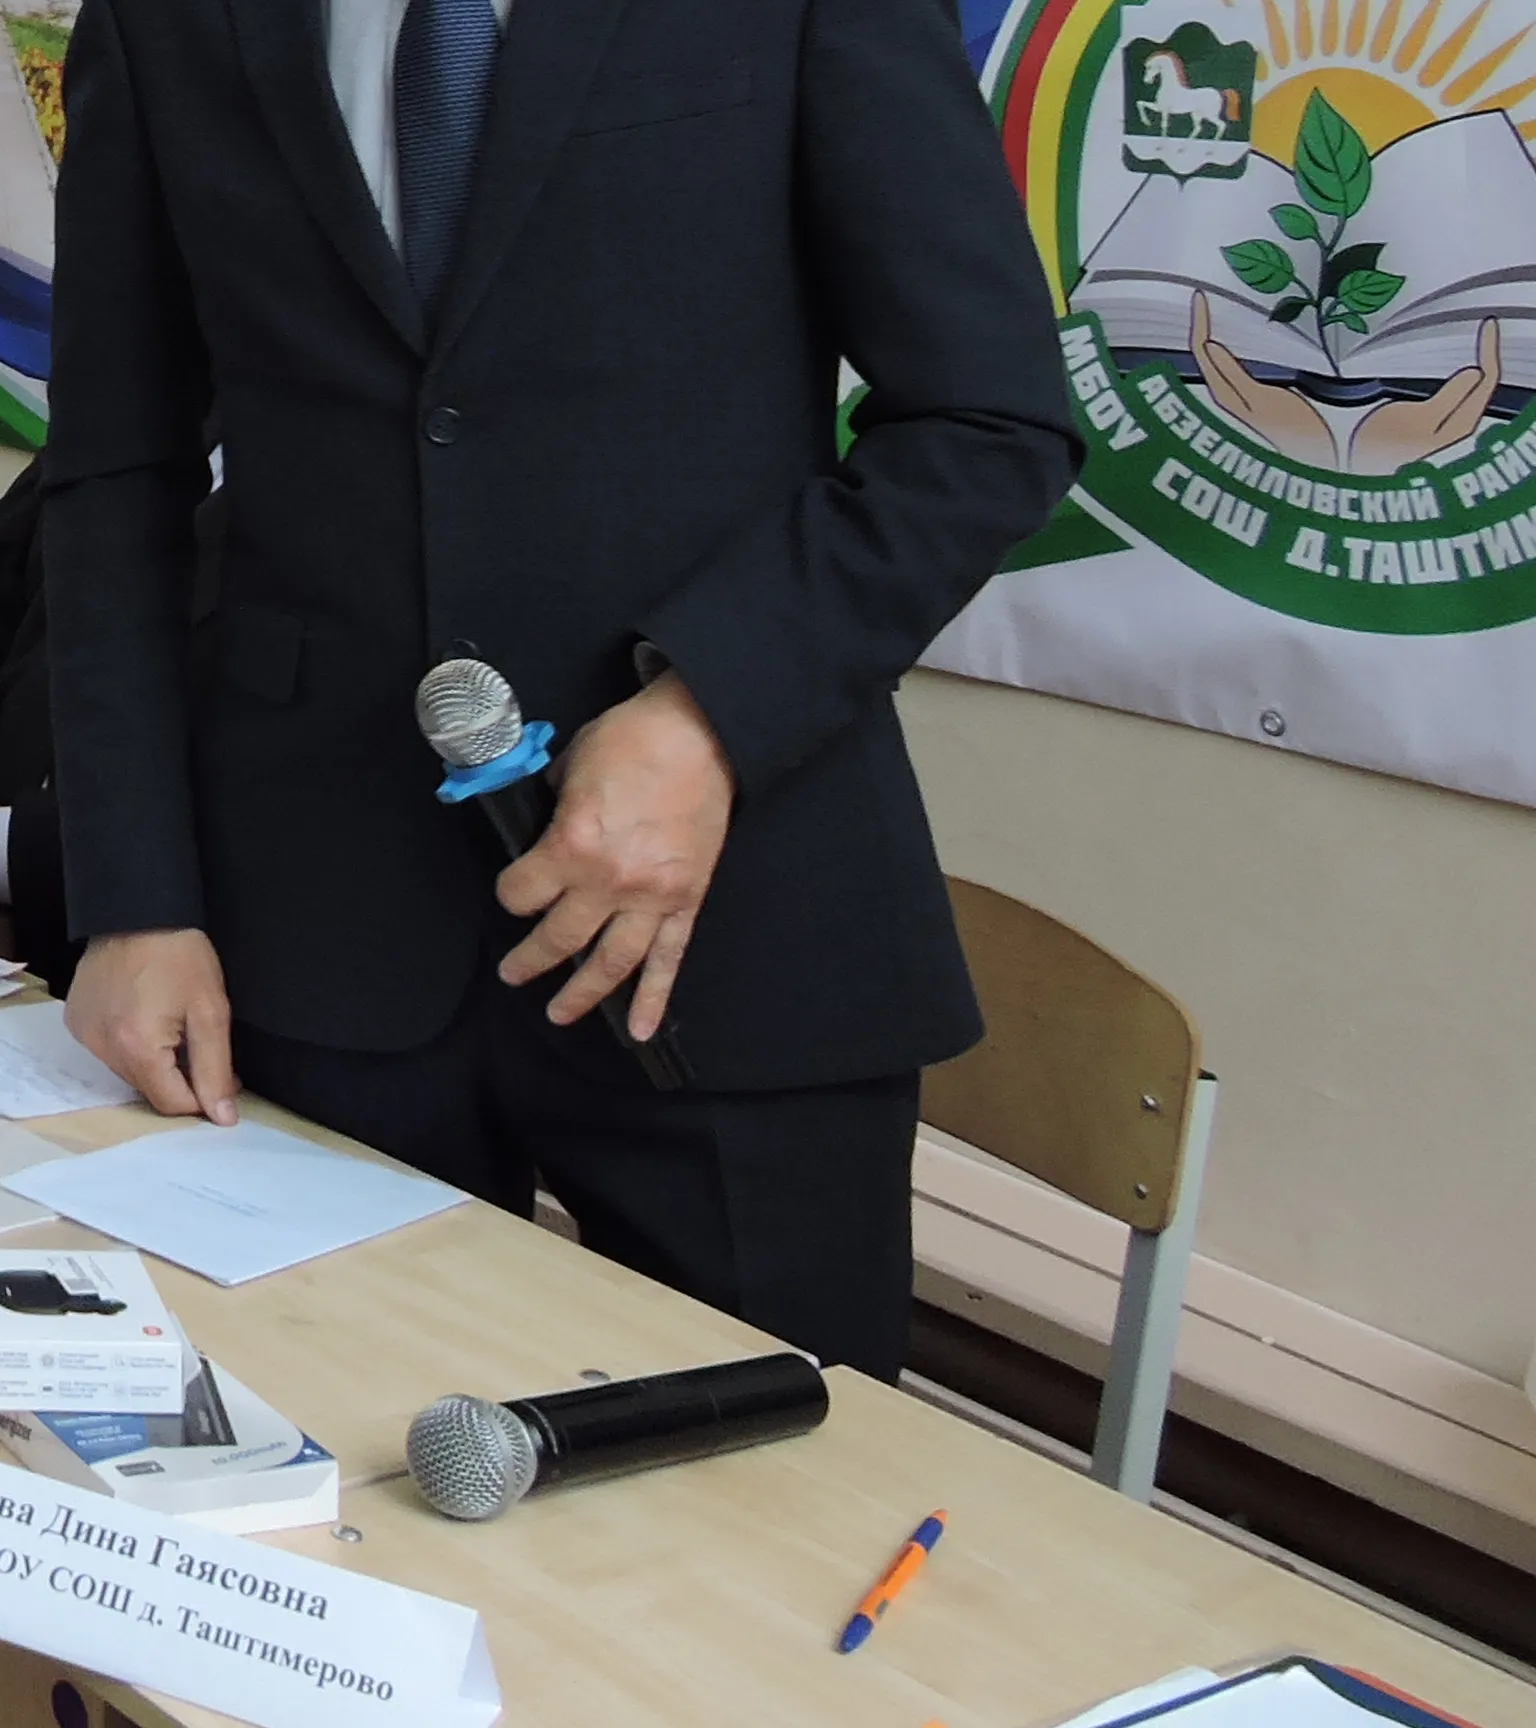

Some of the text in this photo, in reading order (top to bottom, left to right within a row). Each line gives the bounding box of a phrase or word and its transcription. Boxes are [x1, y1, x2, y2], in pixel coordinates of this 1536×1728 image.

[1059, 324, 1148, 452] МБОУ
[1152, 457, 1269, 548] СОШ
[1136, 373, 1536, 524] АБЗЕЛИЛОВСКИЙ РАЙО
[39, 1503, 139, 1559] Дина
[147, 1533, 329, 1622] Гаясовна
[48, 1565, 134, 1615] СОШ
[136, 1599, 164, 1627] д.
[175, 1604, 394, 1702] Таштимерово
